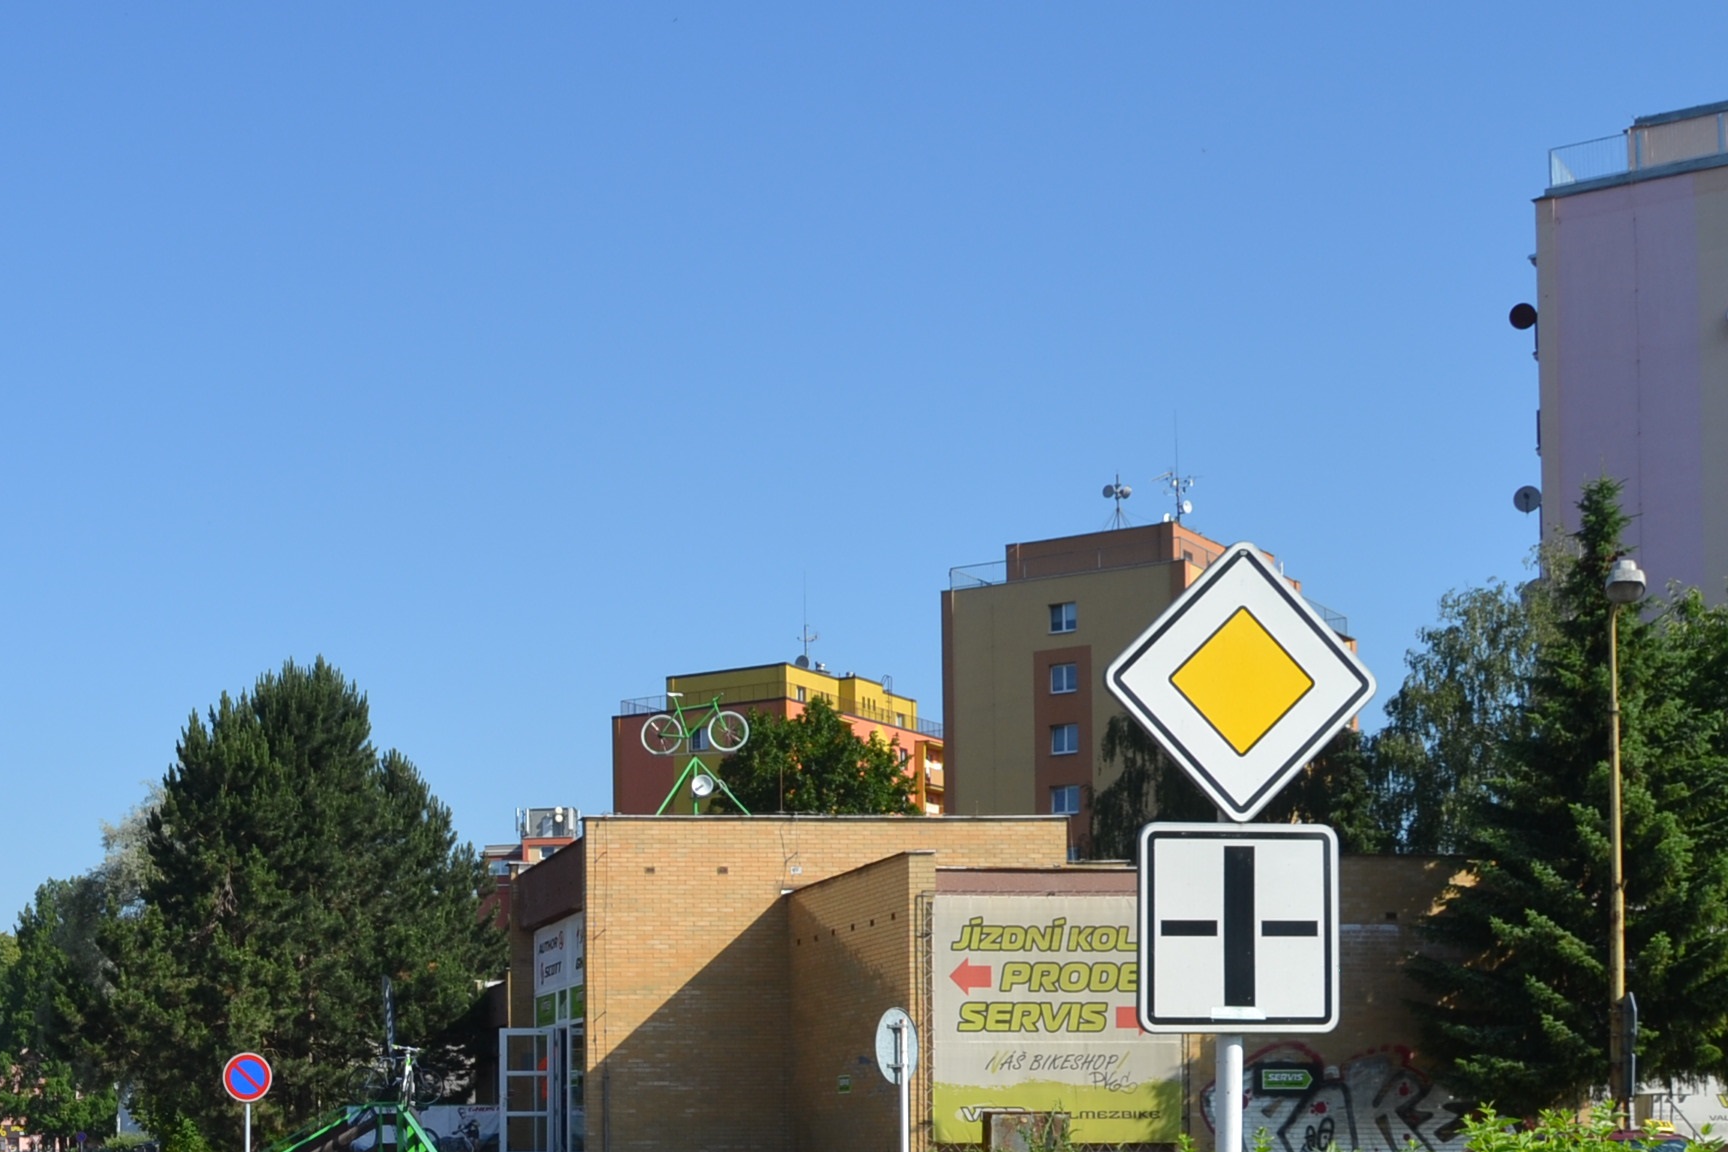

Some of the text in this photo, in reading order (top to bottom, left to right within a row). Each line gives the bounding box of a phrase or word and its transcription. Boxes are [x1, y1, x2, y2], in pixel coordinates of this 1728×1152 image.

[951, 916, 1137, 952] JÍZDNÍ KOL
[544, 962, 562, 978] SCOTT
[999, 961, 1137, 993] PRODE
[957, 1001, 1108, 1033] SERVIS
[985, 1050, 1130, 1074] NÁŠ BIKESHOP!
[1268, 1073, 1304, 1081] SERVIS
[1068, 1110, 1161, 1121] LMEZBIKE
